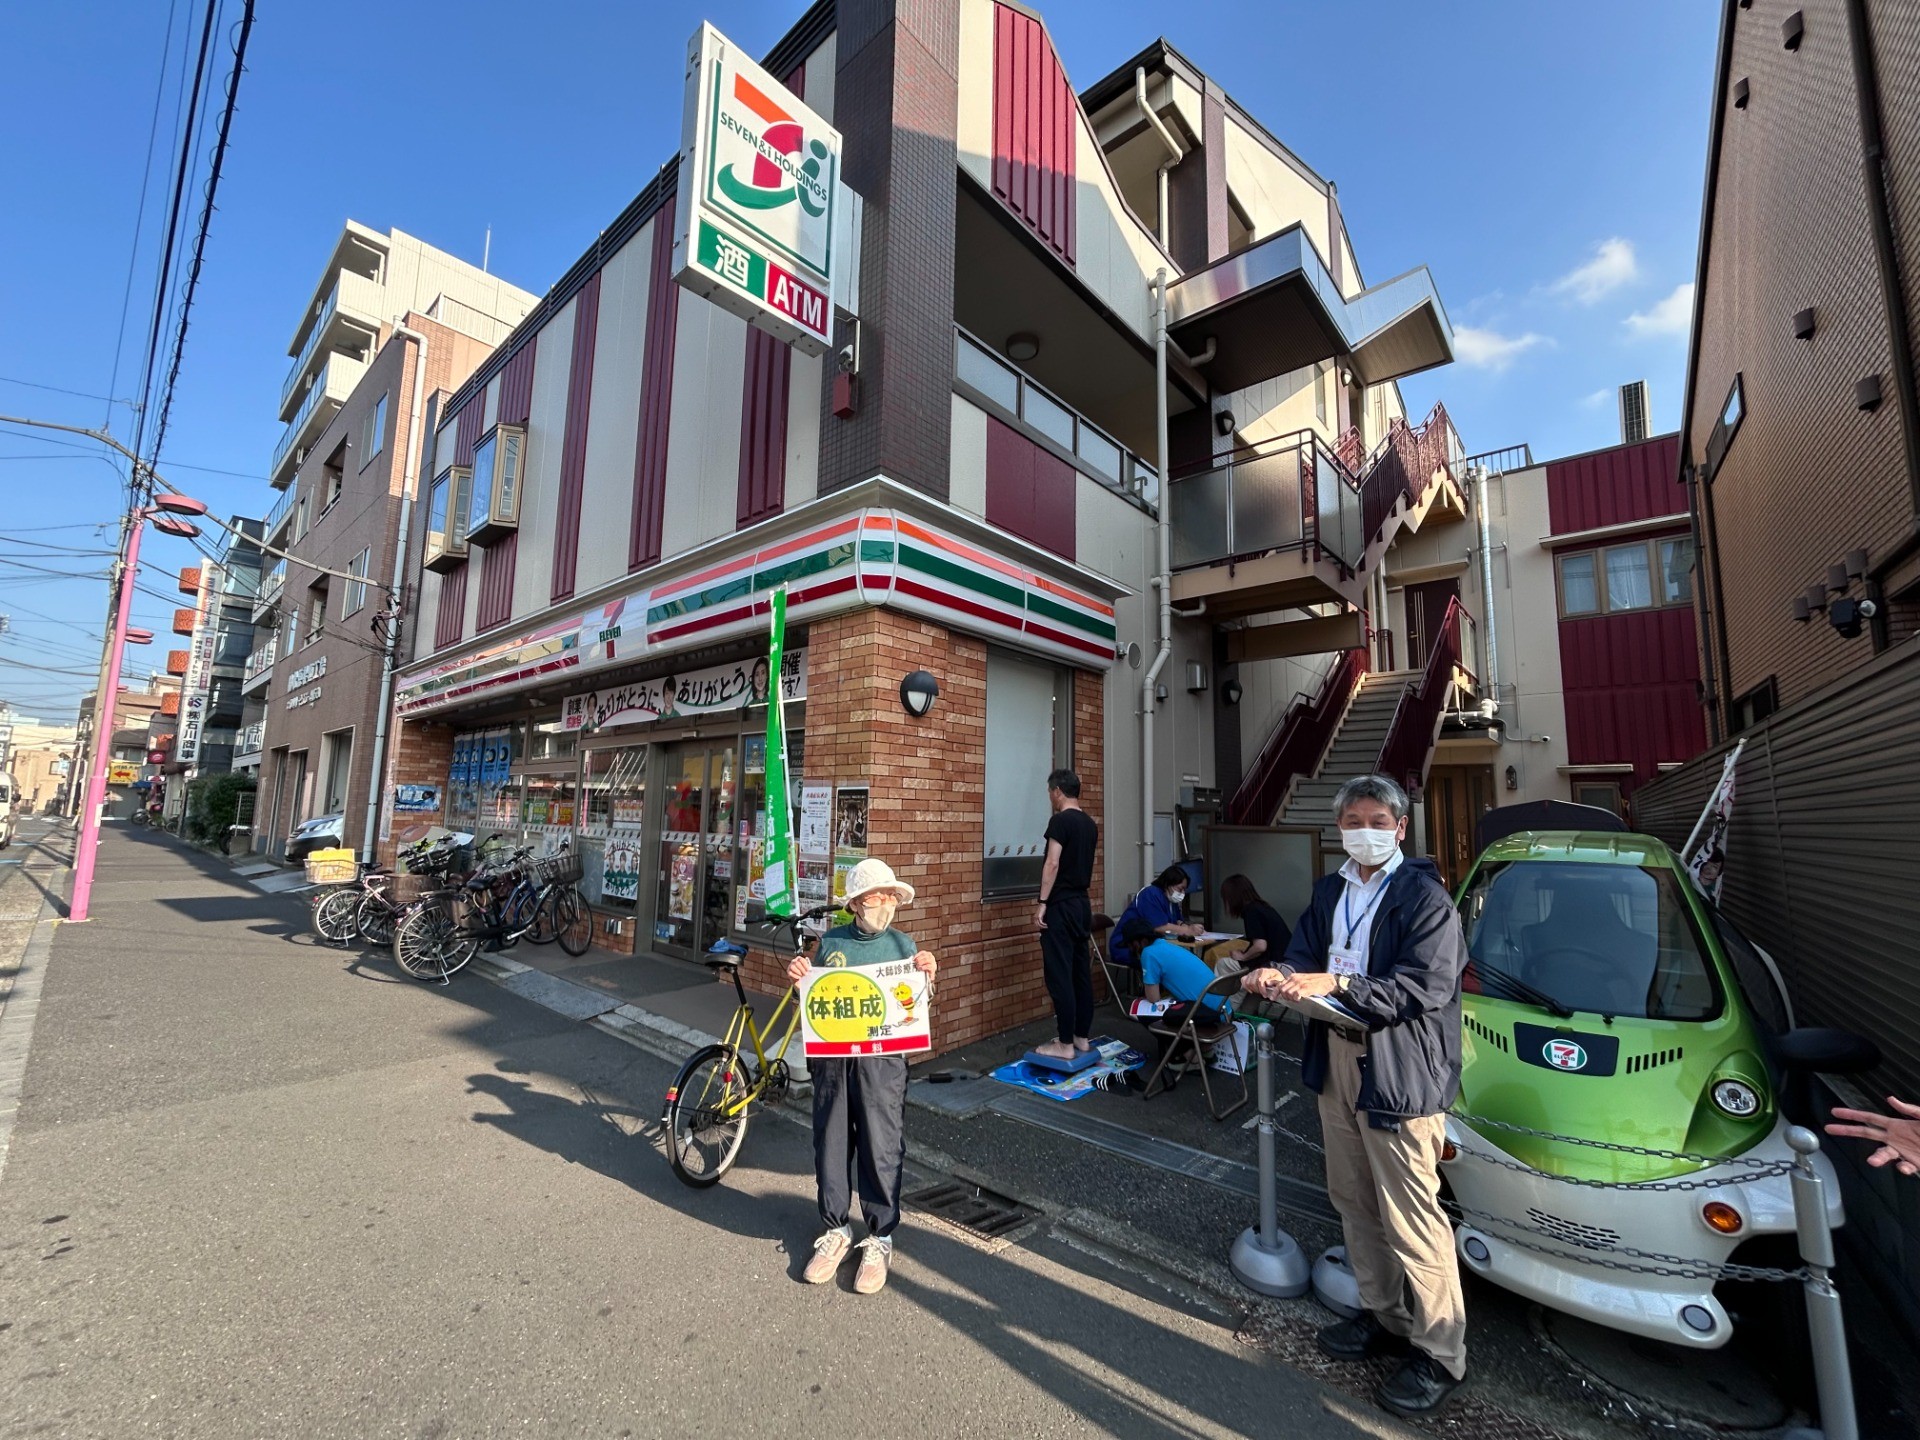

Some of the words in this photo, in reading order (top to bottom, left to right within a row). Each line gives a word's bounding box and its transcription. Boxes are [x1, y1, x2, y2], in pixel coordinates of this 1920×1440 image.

[774, 150, 828, 202] HOLDINGS
[714, 233, 751, 289] 酒
[773, 273, 823, 330] ATM
[677, 667, 745, 706] ありがとう
[782, 676, 801, 697] す!
[808, 994, 882, 1019] 体組成
[867, 1025, 893, 1037] 測定
